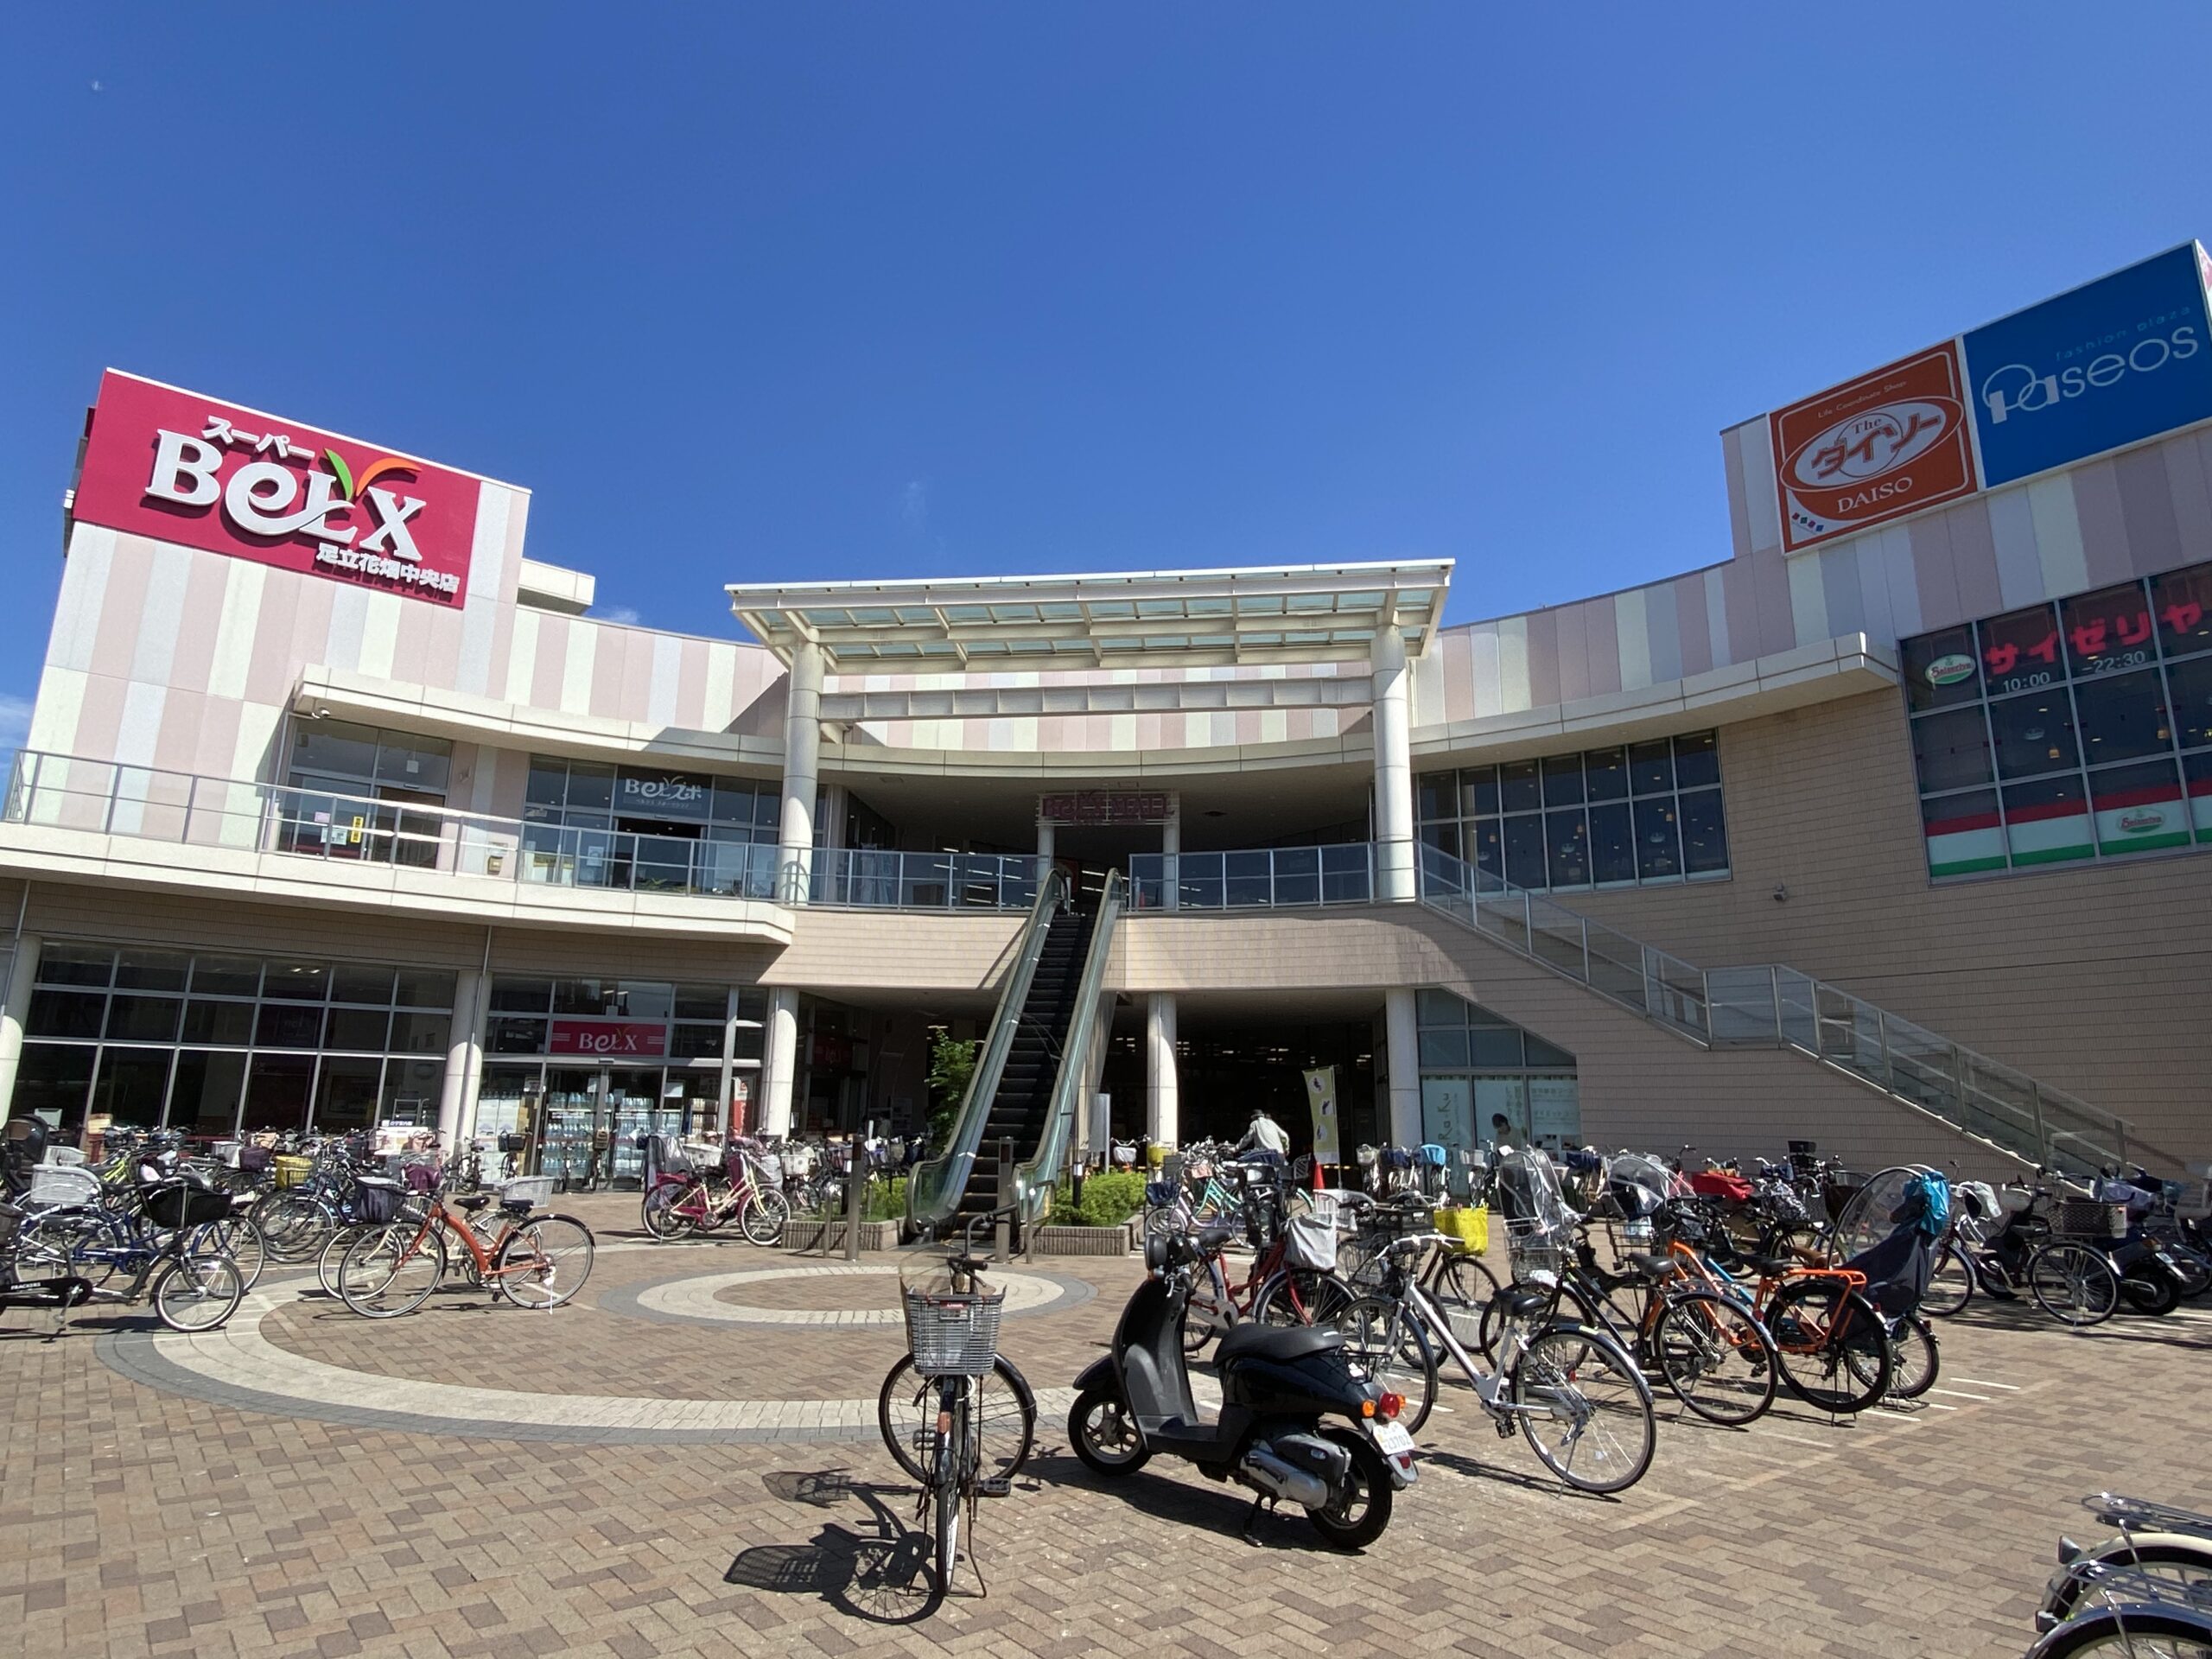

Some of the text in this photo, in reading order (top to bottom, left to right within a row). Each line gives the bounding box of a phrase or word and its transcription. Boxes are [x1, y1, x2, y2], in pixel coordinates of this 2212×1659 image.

[201, 415, 315, 460] スーパー
[1811, 411, 1942, 480] ダイソー
[1852, 415, 1882, 435] The
[1836, 476, 1913, 513] DAISO
[315, 543, 460, 593] 足立花畑中央店
[2003, 671, 2050, 692] 10:00
